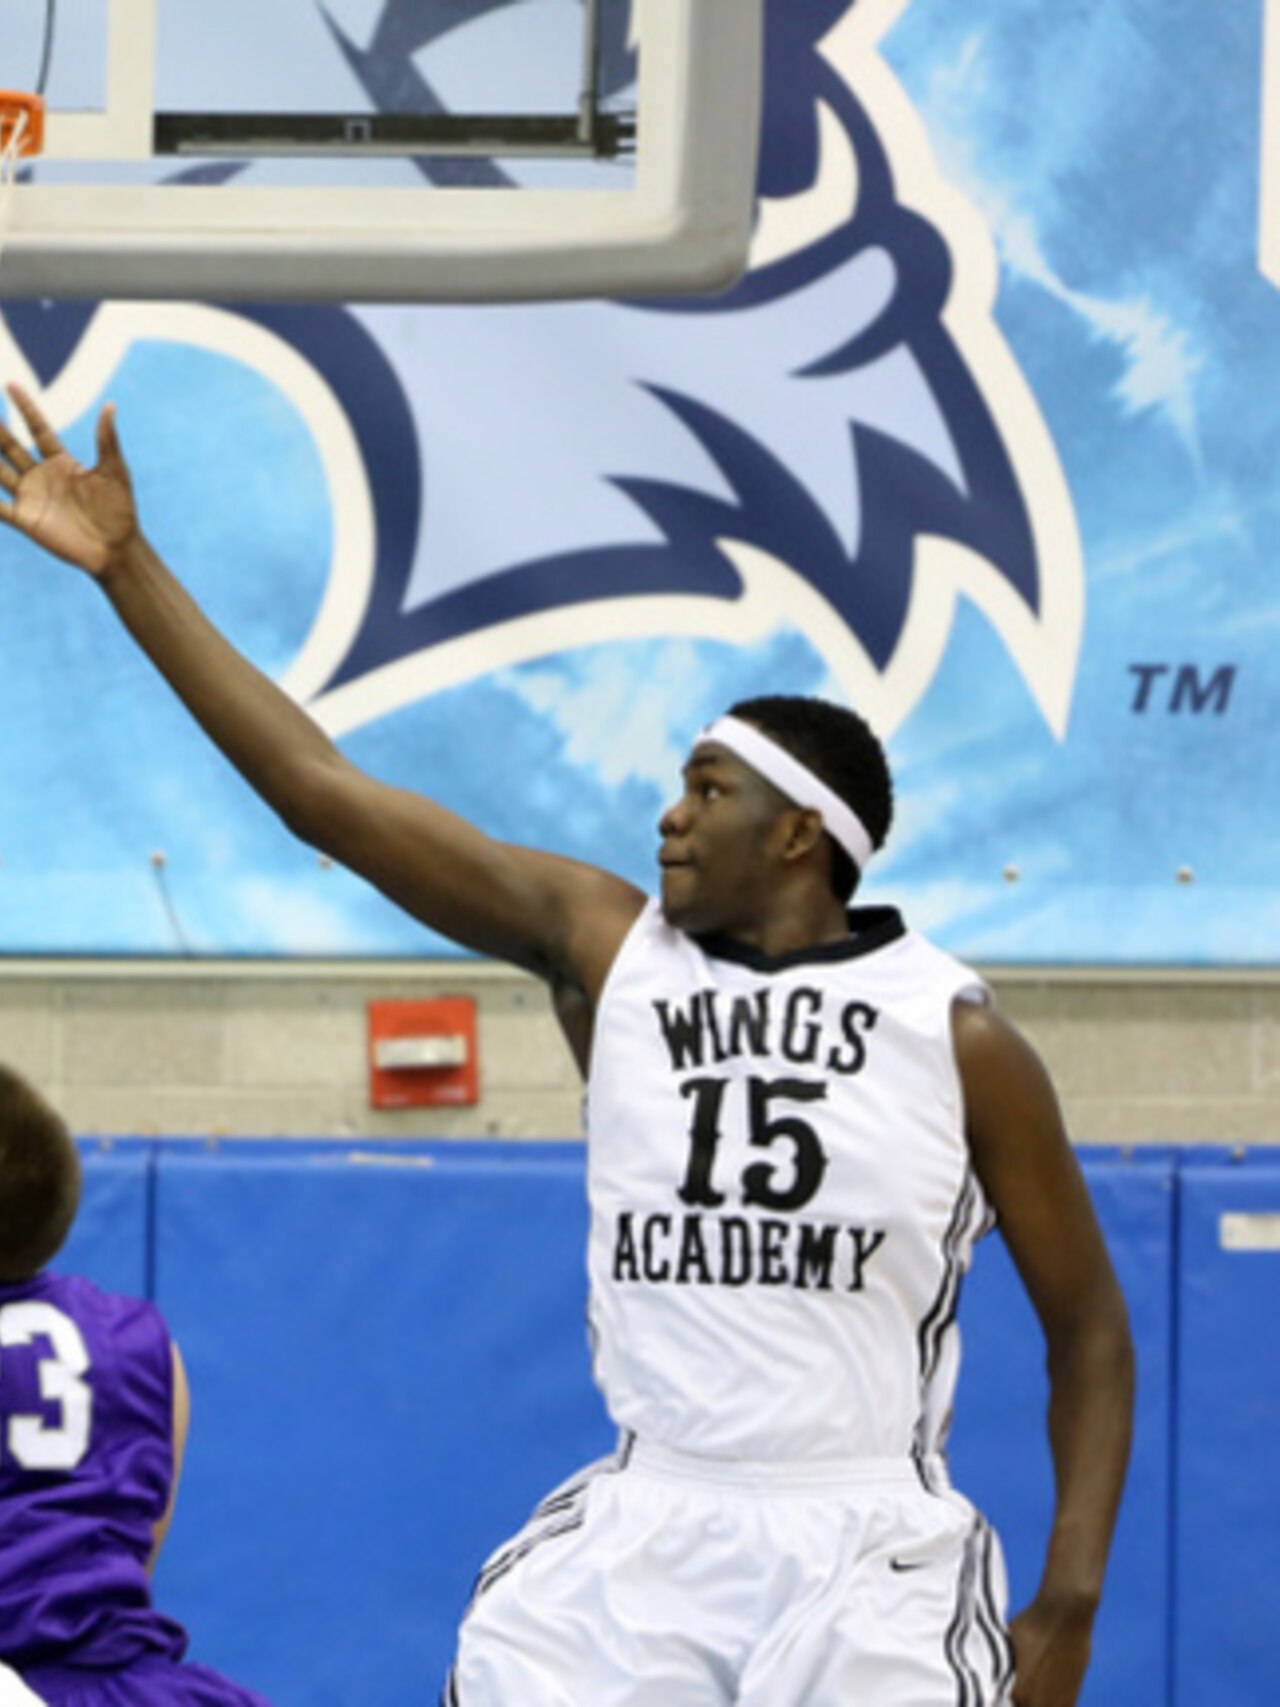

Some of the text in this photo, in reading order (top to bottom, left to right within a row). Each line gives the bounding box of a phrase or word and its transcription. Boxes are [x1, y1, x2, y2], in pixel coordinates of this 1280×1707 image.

[1127, 662, 1237, 715] TM
[652, 986, 879, 1074] WINGS
[676, 1075, 829, 1212] 15
[612, 1212, 886, 1292] ACADEMY
